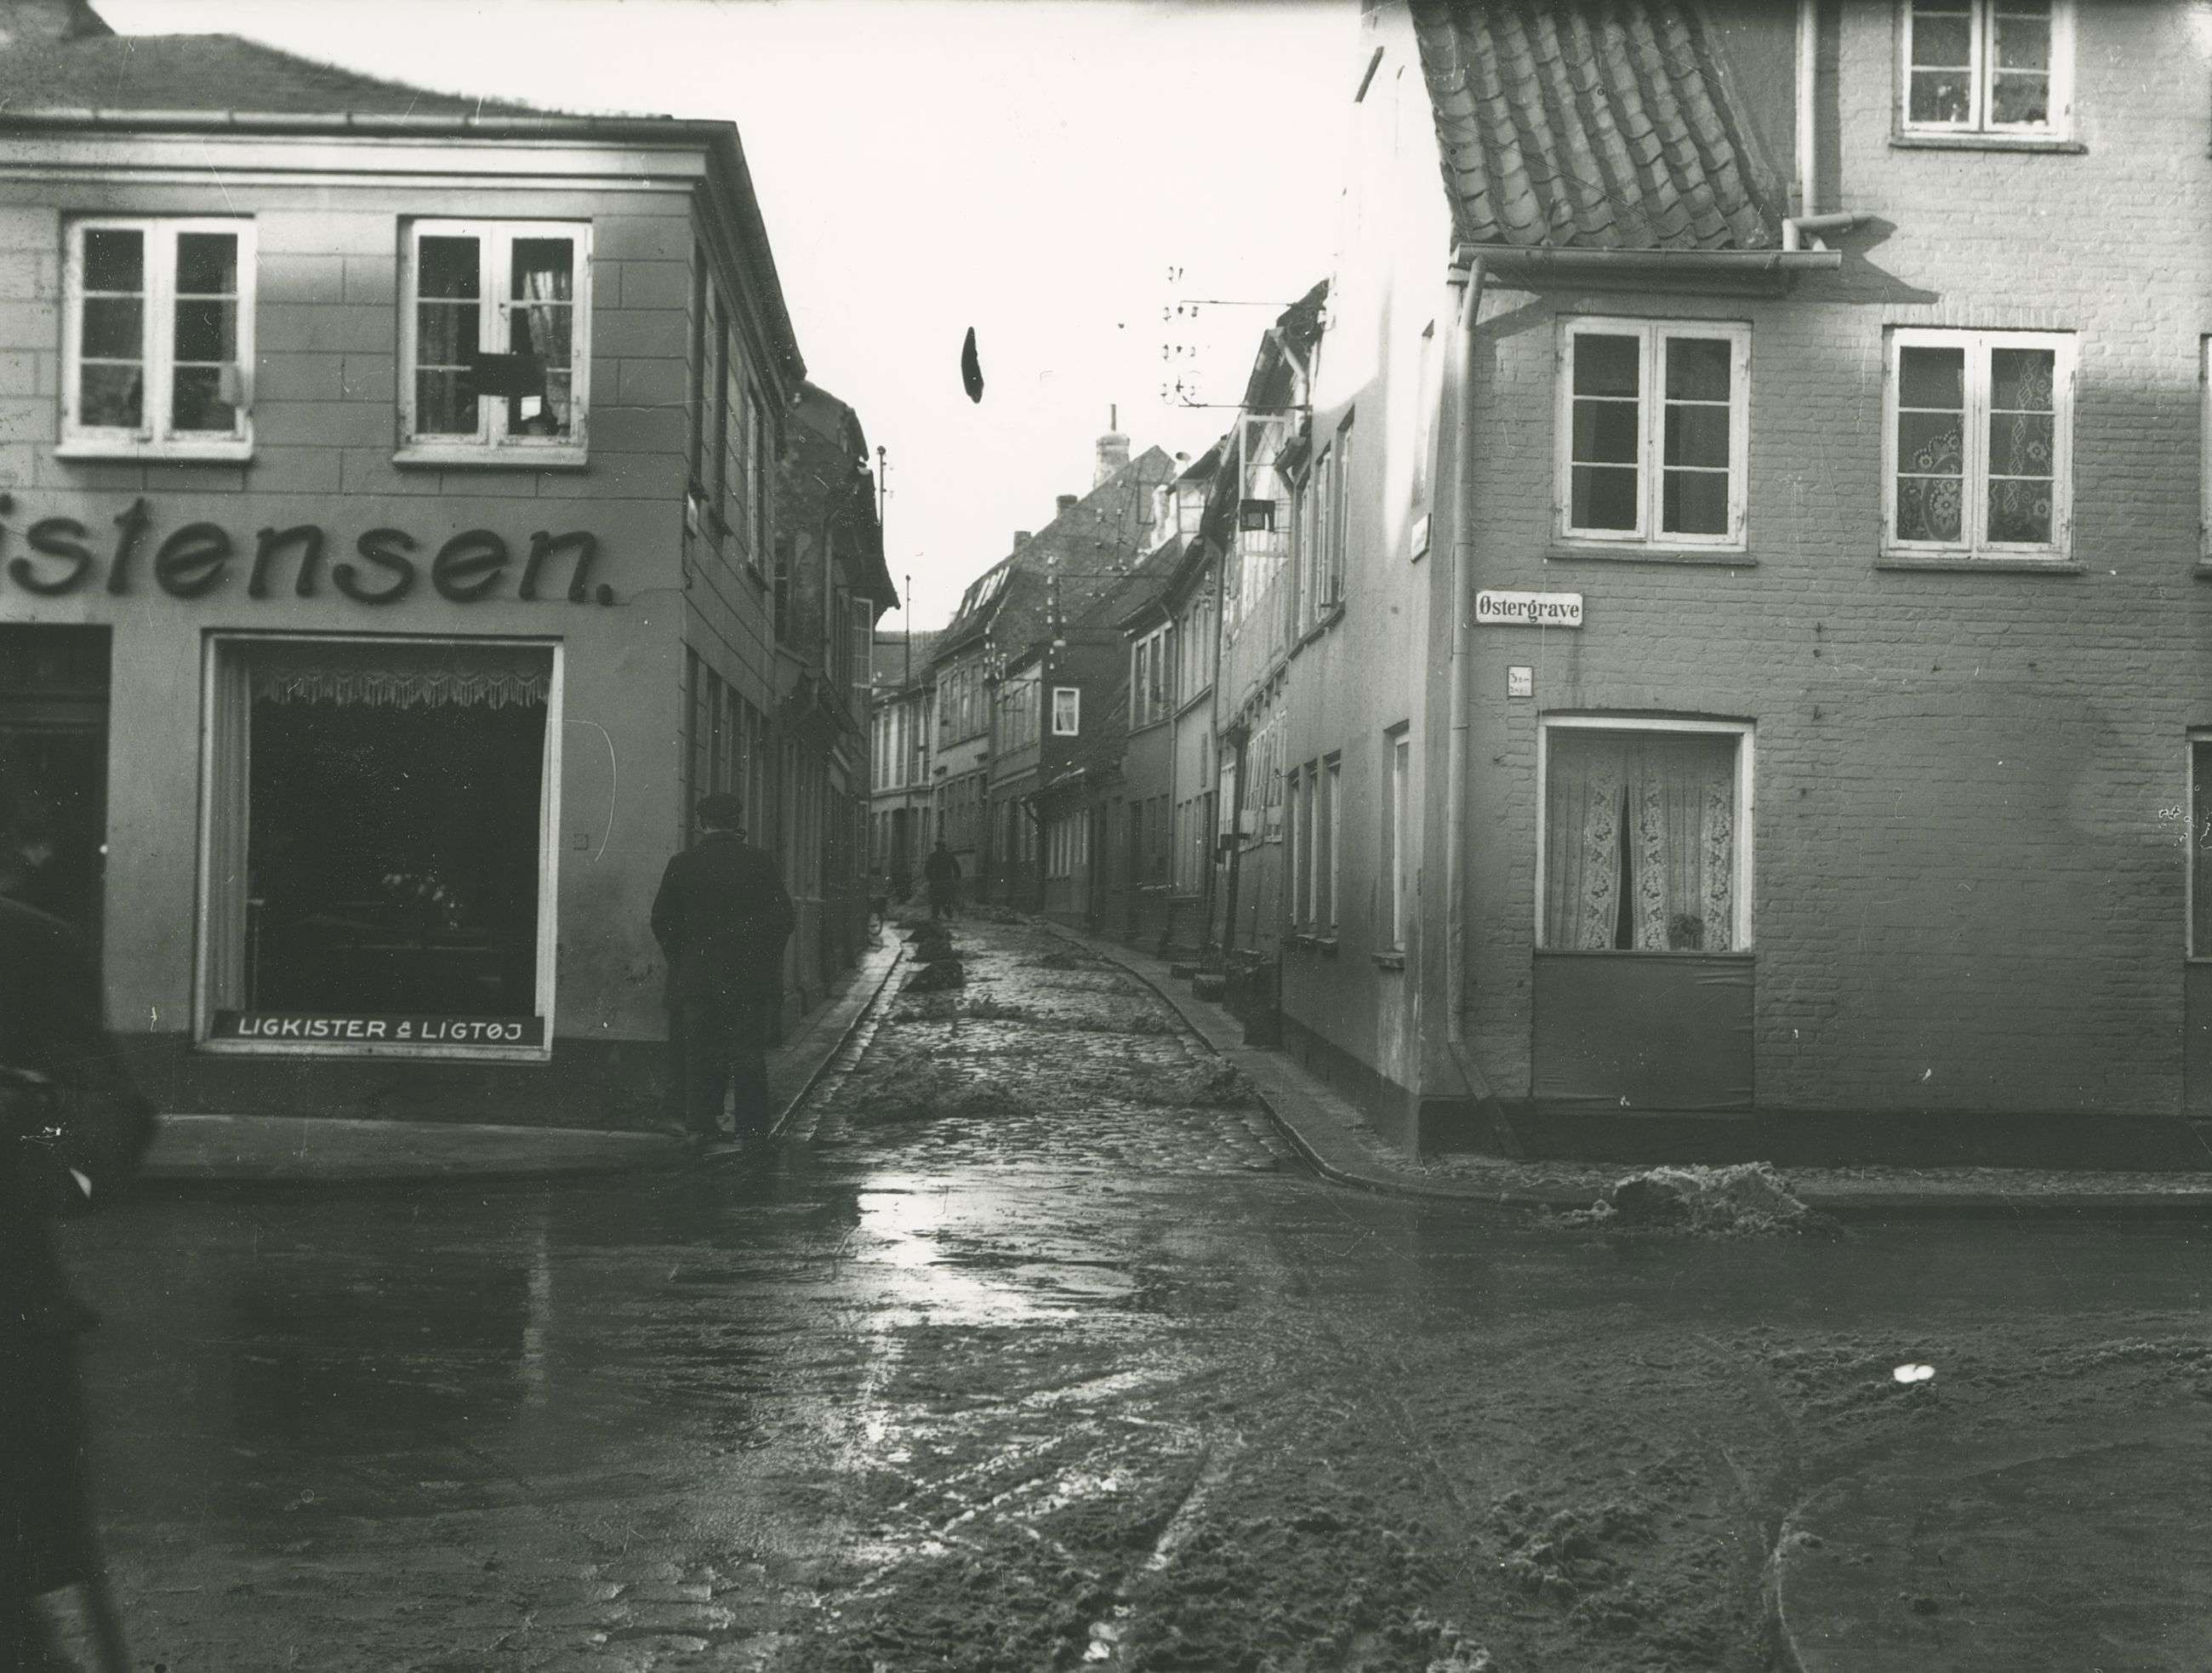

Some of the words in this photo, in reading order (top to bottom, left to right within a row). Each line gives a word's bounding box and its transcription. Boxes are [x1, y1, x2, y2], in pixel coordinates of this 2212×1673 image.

[1479, 595, 1580, 623] Østergrave
[237, 1017, 387, 1038] LIGKISTER
[420, 1021, 523, 1040] LIGTØJ
